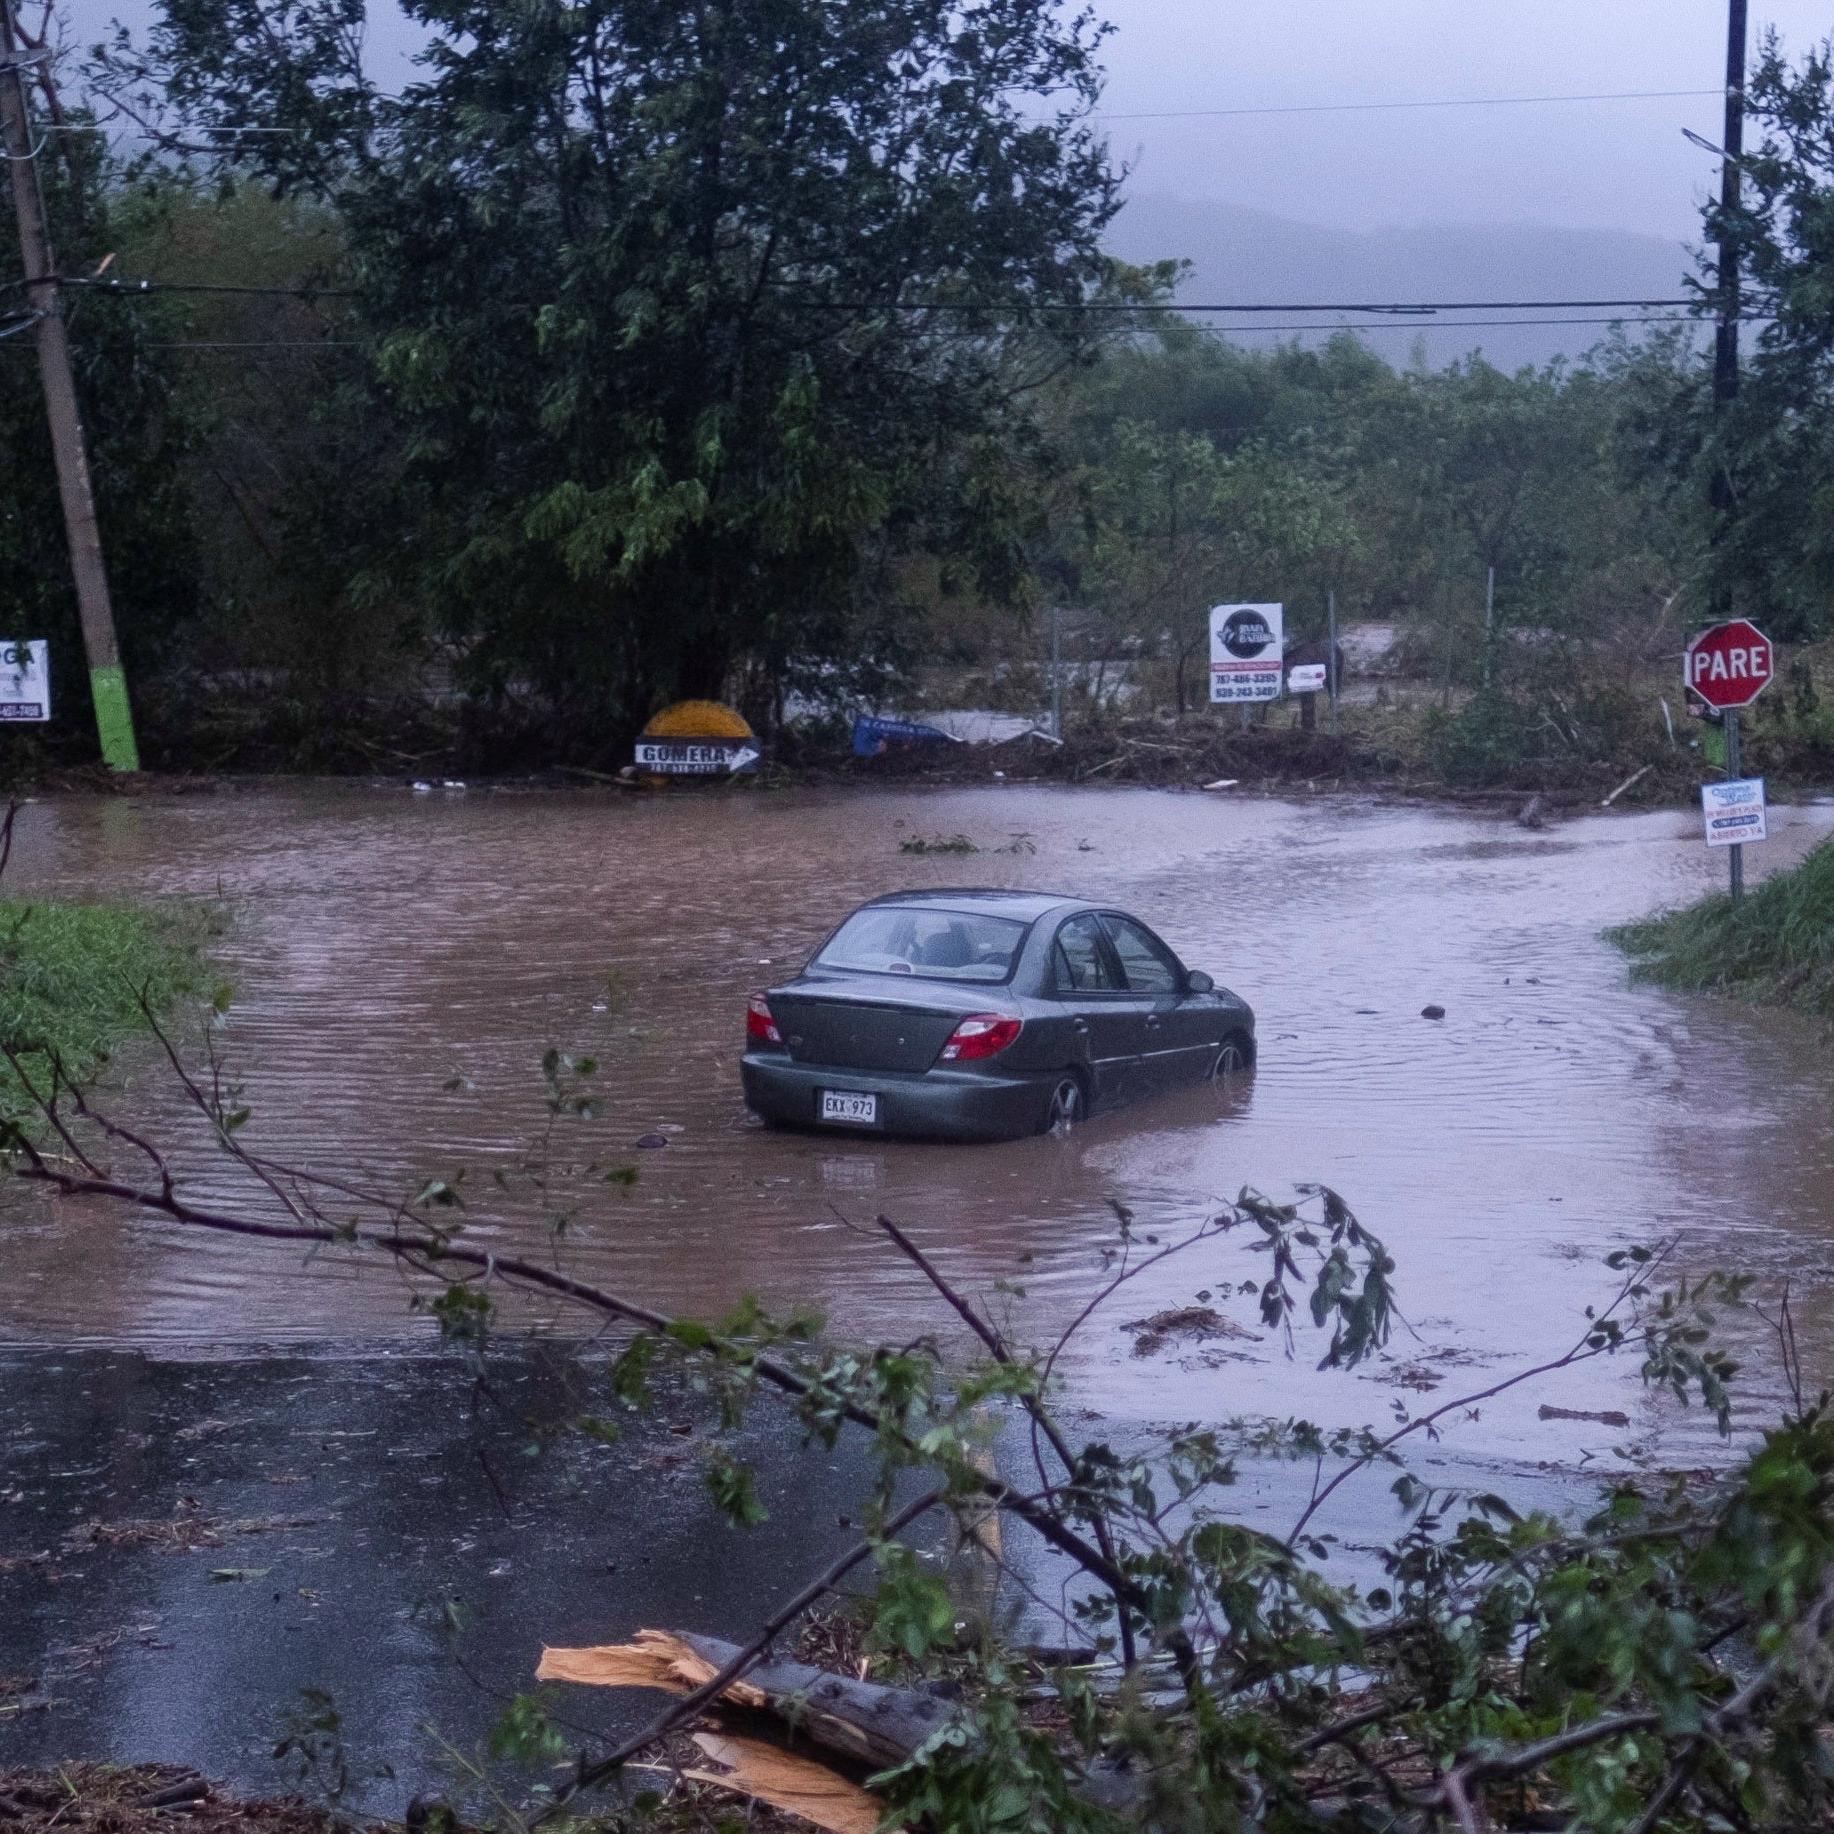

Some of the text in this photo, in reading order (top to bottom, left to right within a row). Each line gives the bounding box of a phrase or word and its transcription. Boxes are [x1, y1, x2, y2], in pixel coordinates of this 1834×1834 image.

[1694, 646, 1768, 683] PARE
[643, 746, 725, 762] GOMERA
[852, 1100, 873, 1115] 973
